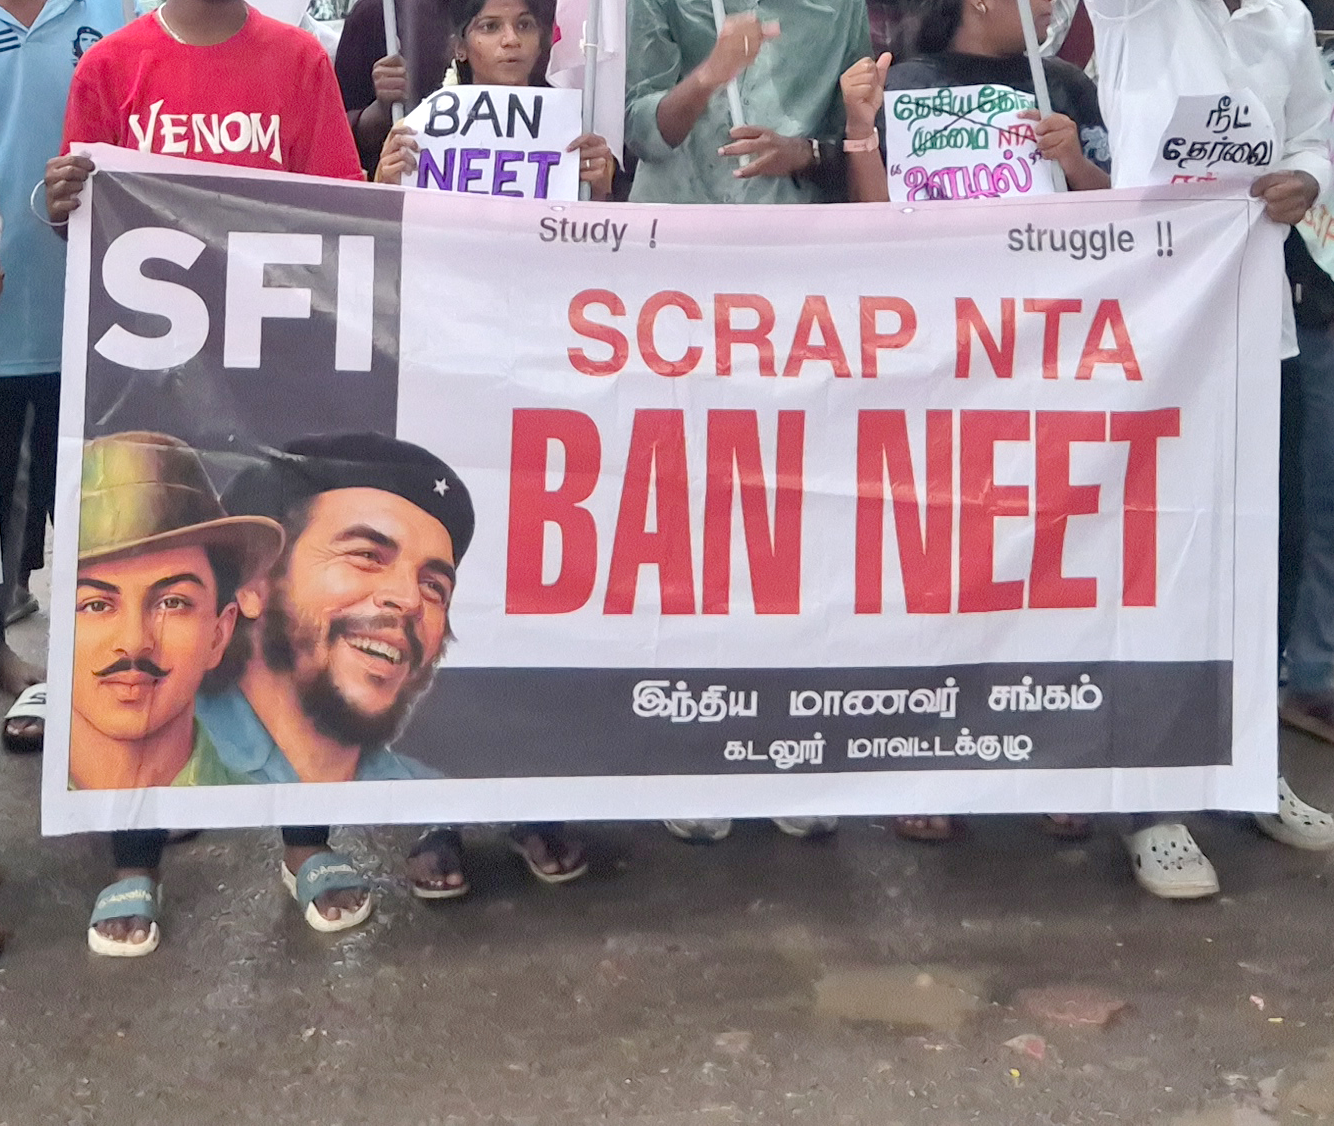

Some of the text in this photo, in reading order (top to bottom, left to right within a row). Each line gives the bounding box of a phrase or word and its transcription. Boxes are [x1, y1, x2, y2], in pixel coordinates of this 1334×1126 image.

[128, 100, 283, 164] VENOM
[424, 90, 543, 139] BAN
[998, 124, 1037, 149] NTA
[1205, 95, 1252, 133] நீட்
[417, 147, 562, 201] NEET
[1163, 136, 1273, 168] தேர்வை
[539, 216, 659, 251] Study !
[1007, 224, 1134, 260] struggle
[93, 226, 375, 372] SFI
[566, 288, 1144, 381] SCRAP NTA
[505, 407, 1181, 615] BAN NEET
[632, 674, 1103, 722] இந்திய மாணவர் சங்கம்
[723, 727, 1033, 769] கடலூர் மாவட்டக்குழு
